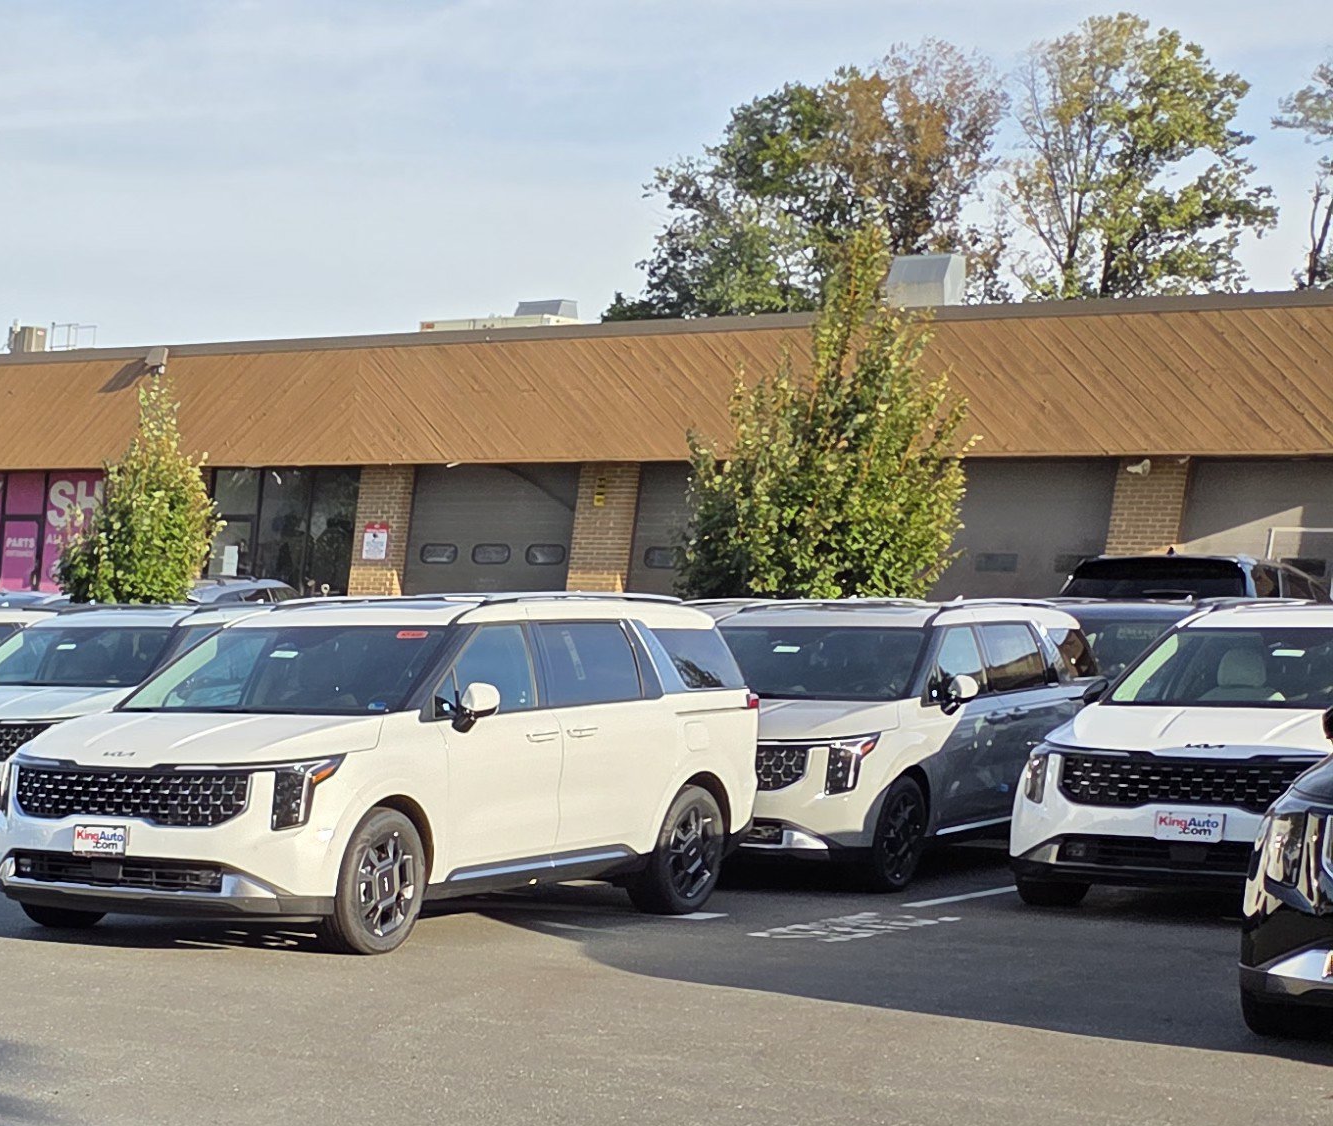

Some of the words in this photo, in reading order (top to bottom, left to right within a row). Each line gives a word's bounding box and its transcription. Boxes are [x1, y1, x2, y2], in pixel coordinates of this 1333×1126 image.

[46, 480, 104, 528] SH
[5, 537, 35, 548] PARTS
[1158, 816, 1219, 831] KingAuto
[76, 830, 124, 843] KingAuto
